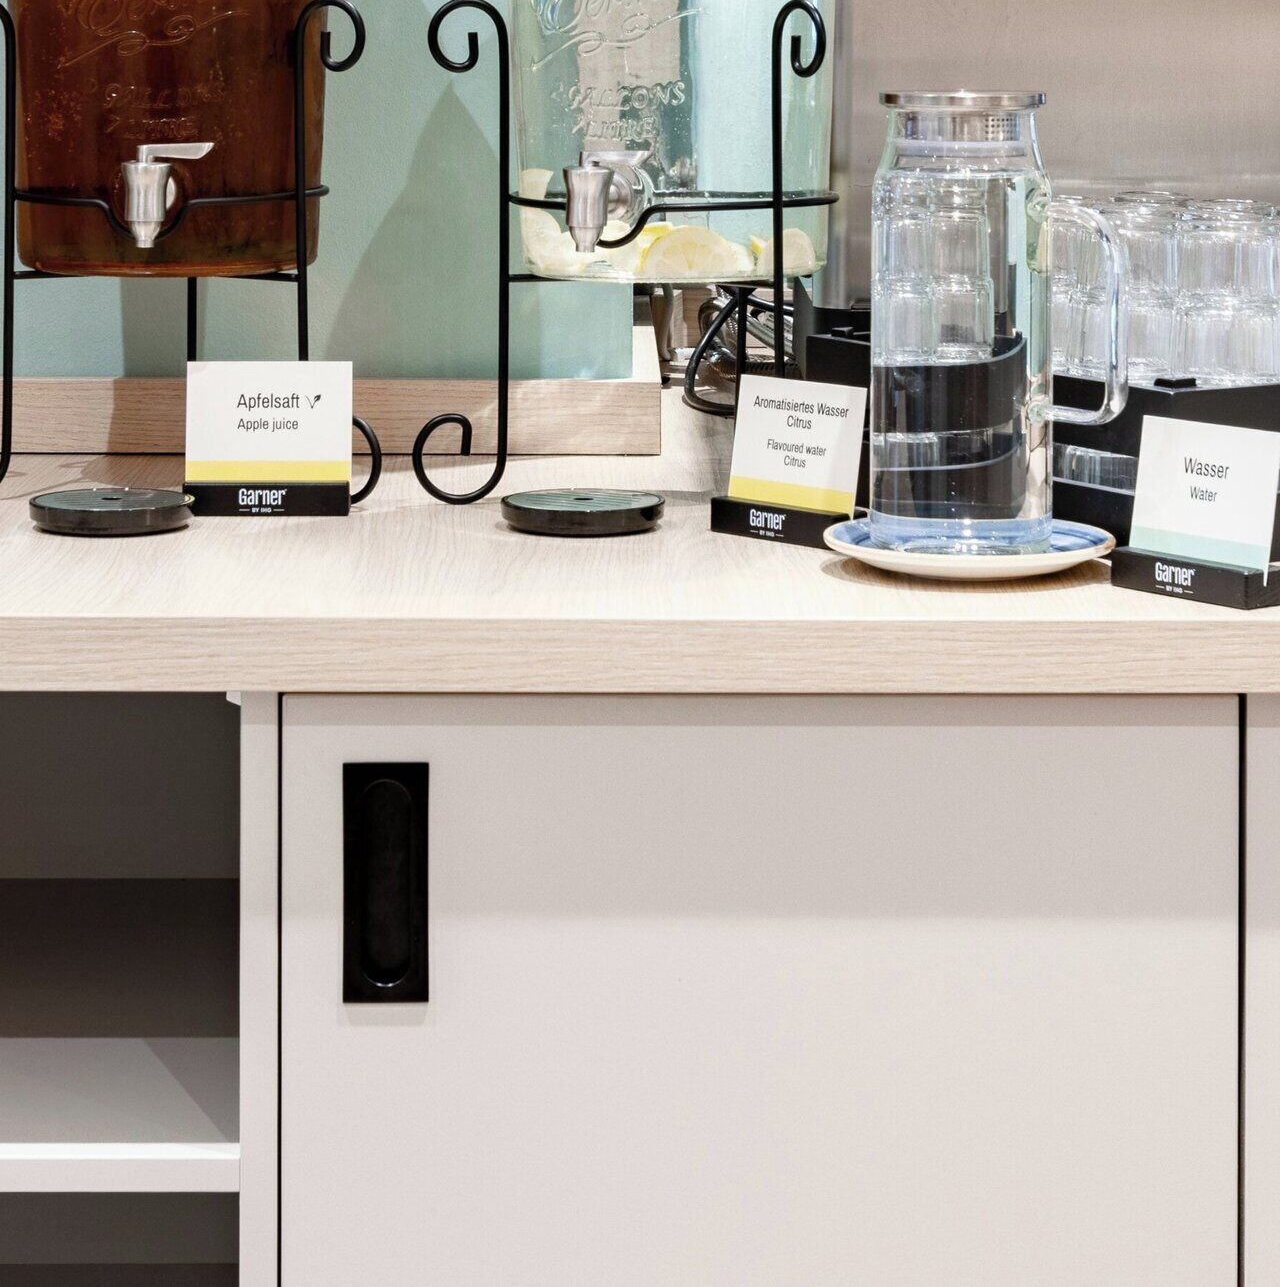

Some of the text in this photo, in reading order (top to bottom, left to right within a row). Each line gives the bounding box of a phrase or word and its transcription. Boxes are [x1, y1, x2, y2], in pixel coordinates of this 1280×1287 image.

[237, 393, 300, 411] Apfelsaft
[753, 395, 850, 418] Aromatisiertes Wasser
[237, 417, 299, 432] Apple juice
[786, 415, 812, 430] Citrus
[766, 439, 827, 457] Flavoured water
[783, 455, 807, 468] Citrus
[1184, 457, 1230, 480] Wasser
[238, 488, 286, 505] Garner
[1190, 485, 1218, 502] Water
[750, 508, 785, 531] Garner
[1155, 561, 1195, 587] Garner
